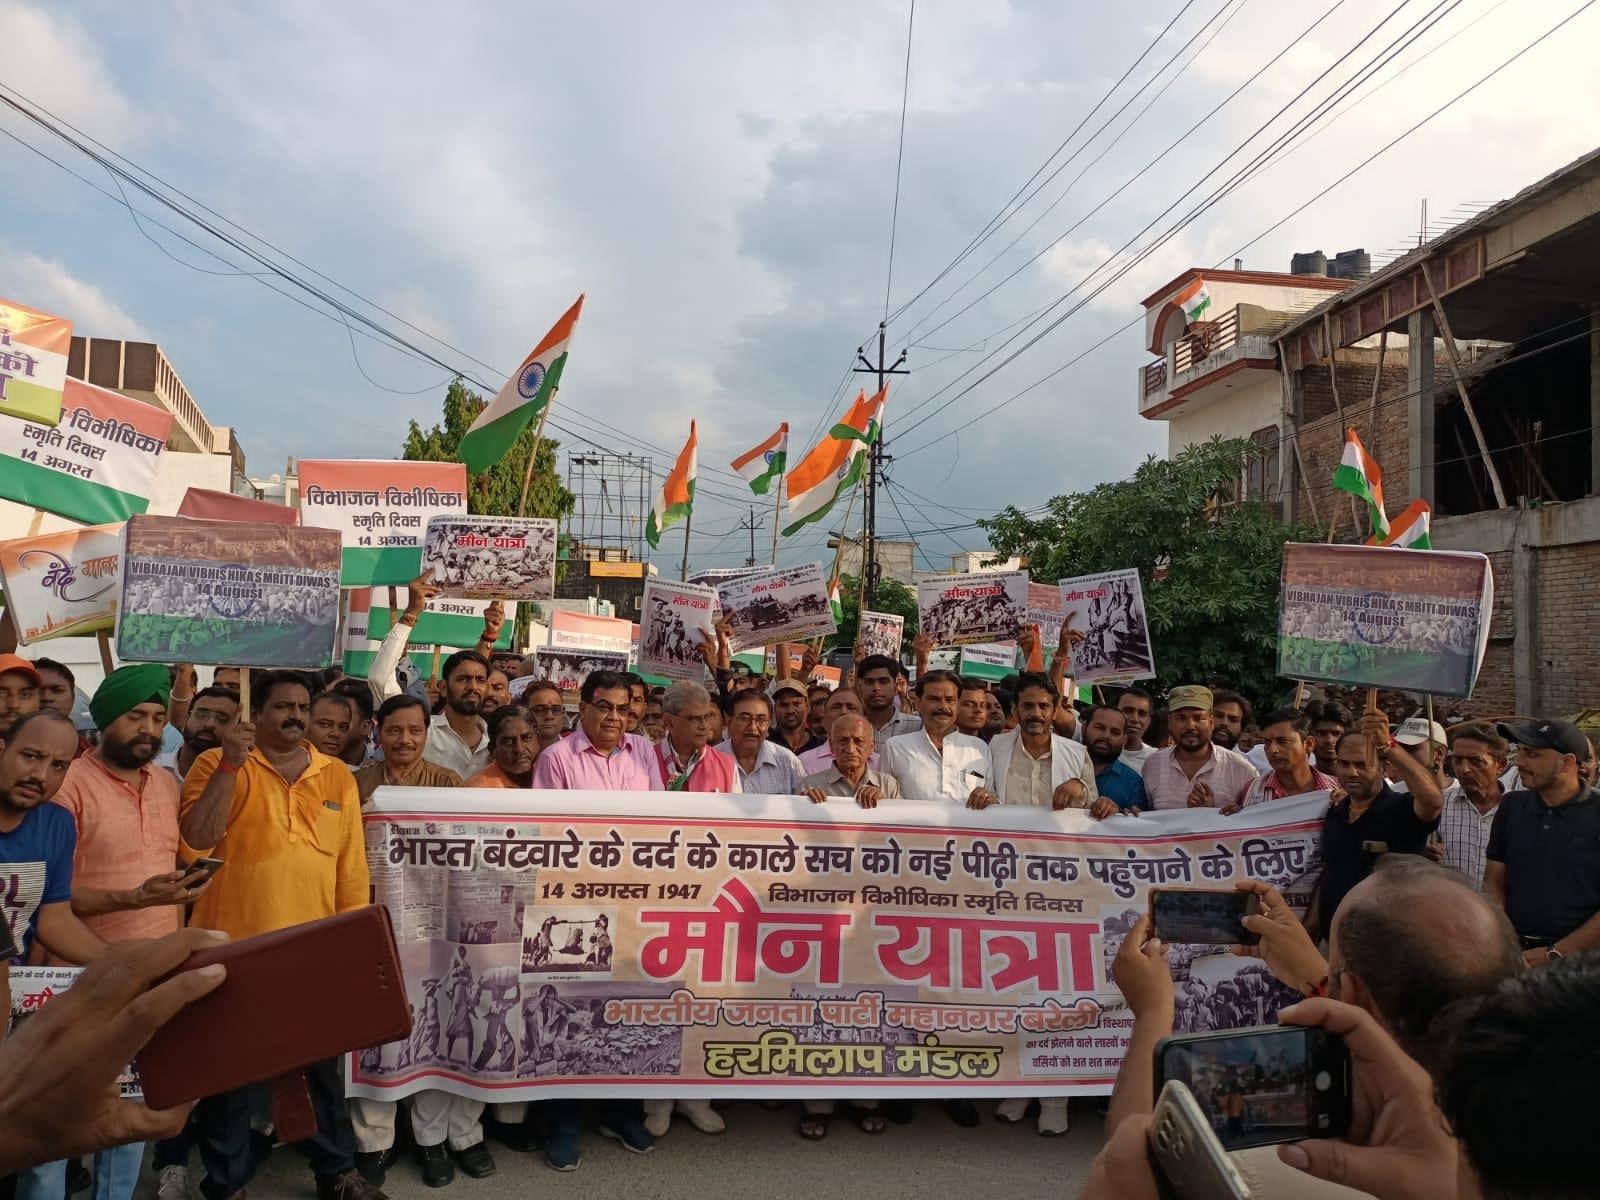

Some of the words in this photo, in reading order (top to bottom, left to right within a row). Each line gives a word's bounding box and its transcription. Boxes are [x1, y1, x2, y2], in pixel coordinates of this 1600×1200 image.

[23, 424, 65, 448] स्मृति
[66, 435, 107, 461] दिवस
[70, 407, 165, 457] विभीषिका
[21, 448, 38, 462] 14
[42, 455, 94, 479] अगस्त
[307, 486, 379, 507] विभाजन
[385, 487, 463, 508] विभीषिका
[352, 512, 386, 532] स्मृति
[388, 513, 421, 528] दिवस
[358, 535, 372, 546] 14
[376, 535, 417, 547] अगस्त
[456, 532, 489, 547] मौन
[132, 562, 187, 578] VIBHAJAN
[295, 574, 331, 589] DIWAS
[197, 583, 211, 595] 14
[213, 583, 263, 600] August
[439, 602, 476, 615] अगस्त
[1342, 611, 1355, 622] 14
[1358, 611, 1406, 627] August
[1437, 605, 1475, 619] DIWAS
[389, 837, 476, 867] भारत
[484, 828, 583, 870] बंटवारे
[588, 830, 625, 868] के
[632, 830, 680, 868] दर्द
[687, 833, 720, 870] के
[728, 834, 799, 872] काले
[804, 845, 853, 873] सच
[861, 839, 902, 875] को
[908, 840, 955, 880] नई
[962, 841, 1020, 890] पीढ़ी
[1026, 854, 1080, 883] तक
[1088, 847, 1192, 898] पहुंचाने
[1198, 844, 1234, 880] के
[1242, 839, 1307, 877] लिए
[542, 884, 565, 900] 14
[570, 882, 651, 900] अगस्त
[656, 883, 702, 900] 1947
[768, 882, 856, 904] विभाजन
[862, 885, 958, 908] विभीषिका
[964, 890, 1019, 915] स्मृति
[1026, 893, 1084, 913] दिवस
[640, 877, 852, 984] मौन
[875, 914, 1100, 992] यात्रा
[603, 991, 718, 1026] भारतीय
[724, 998, 816, 1026] जनता
[820, 992, 882, 1028] पार्टी
[887, 1002, 1017, 1034] महानगर
[1021, 999, 1102, 1034] बरेली
[704, 1030, 885, 1077] हरमिलाप
[895, 1034, 1003, 1078] मंडल
